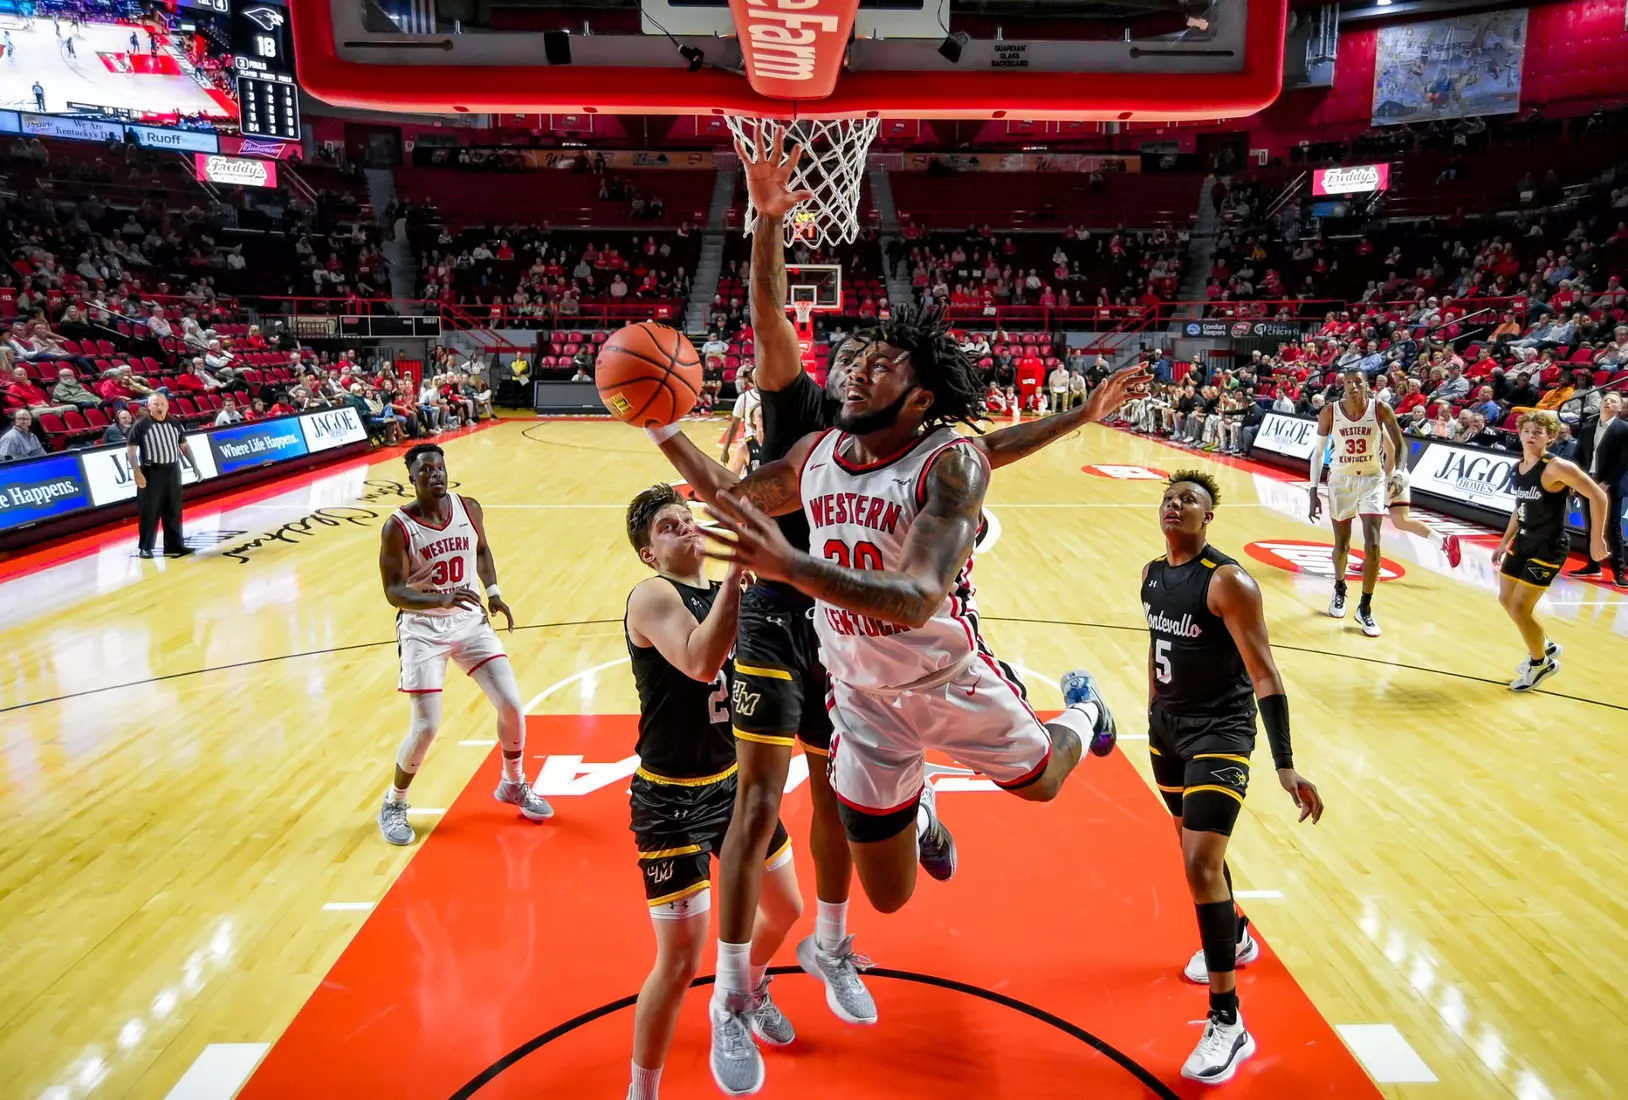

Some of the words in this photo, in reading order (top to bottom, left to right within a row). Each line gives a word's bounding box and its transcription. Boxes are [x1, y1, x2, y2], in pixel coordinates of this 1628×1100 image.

[257, 36, 276, 57] 18
[747, 8, 839, 80] Farm
[90, 122, 103, 130] Are
[147, 132, 182, 145] Ruoff
[210, 159, 265, 177] Freddy's
[1327, 168, 1377, 184] Freddy's
[311, 410, 357, 438] JAGOE
[1262, 417, 1315, 446] JAGOE
[1339, 426, 1372, 437] WESTERN
[219, 442, 249, 459] Where
[250, 437, 265, 452] Life
[264, 433, 299, 451] Happens.
[1345, 439, 1367, 455] 33
[1339, 455, 1373, 463] KENTUCKY
[8, 480, 79, 505] Happens.
[1459, 479, 1494, 494] HOMES
[809, 492, 903, 535] WESTERN
[419, 536, 470, 560] WESTERN
[432, 556, 464, 585] 30
[1144, 602, 1202, 638] Montevallo
[1155, 638, 1173, 684] 5
